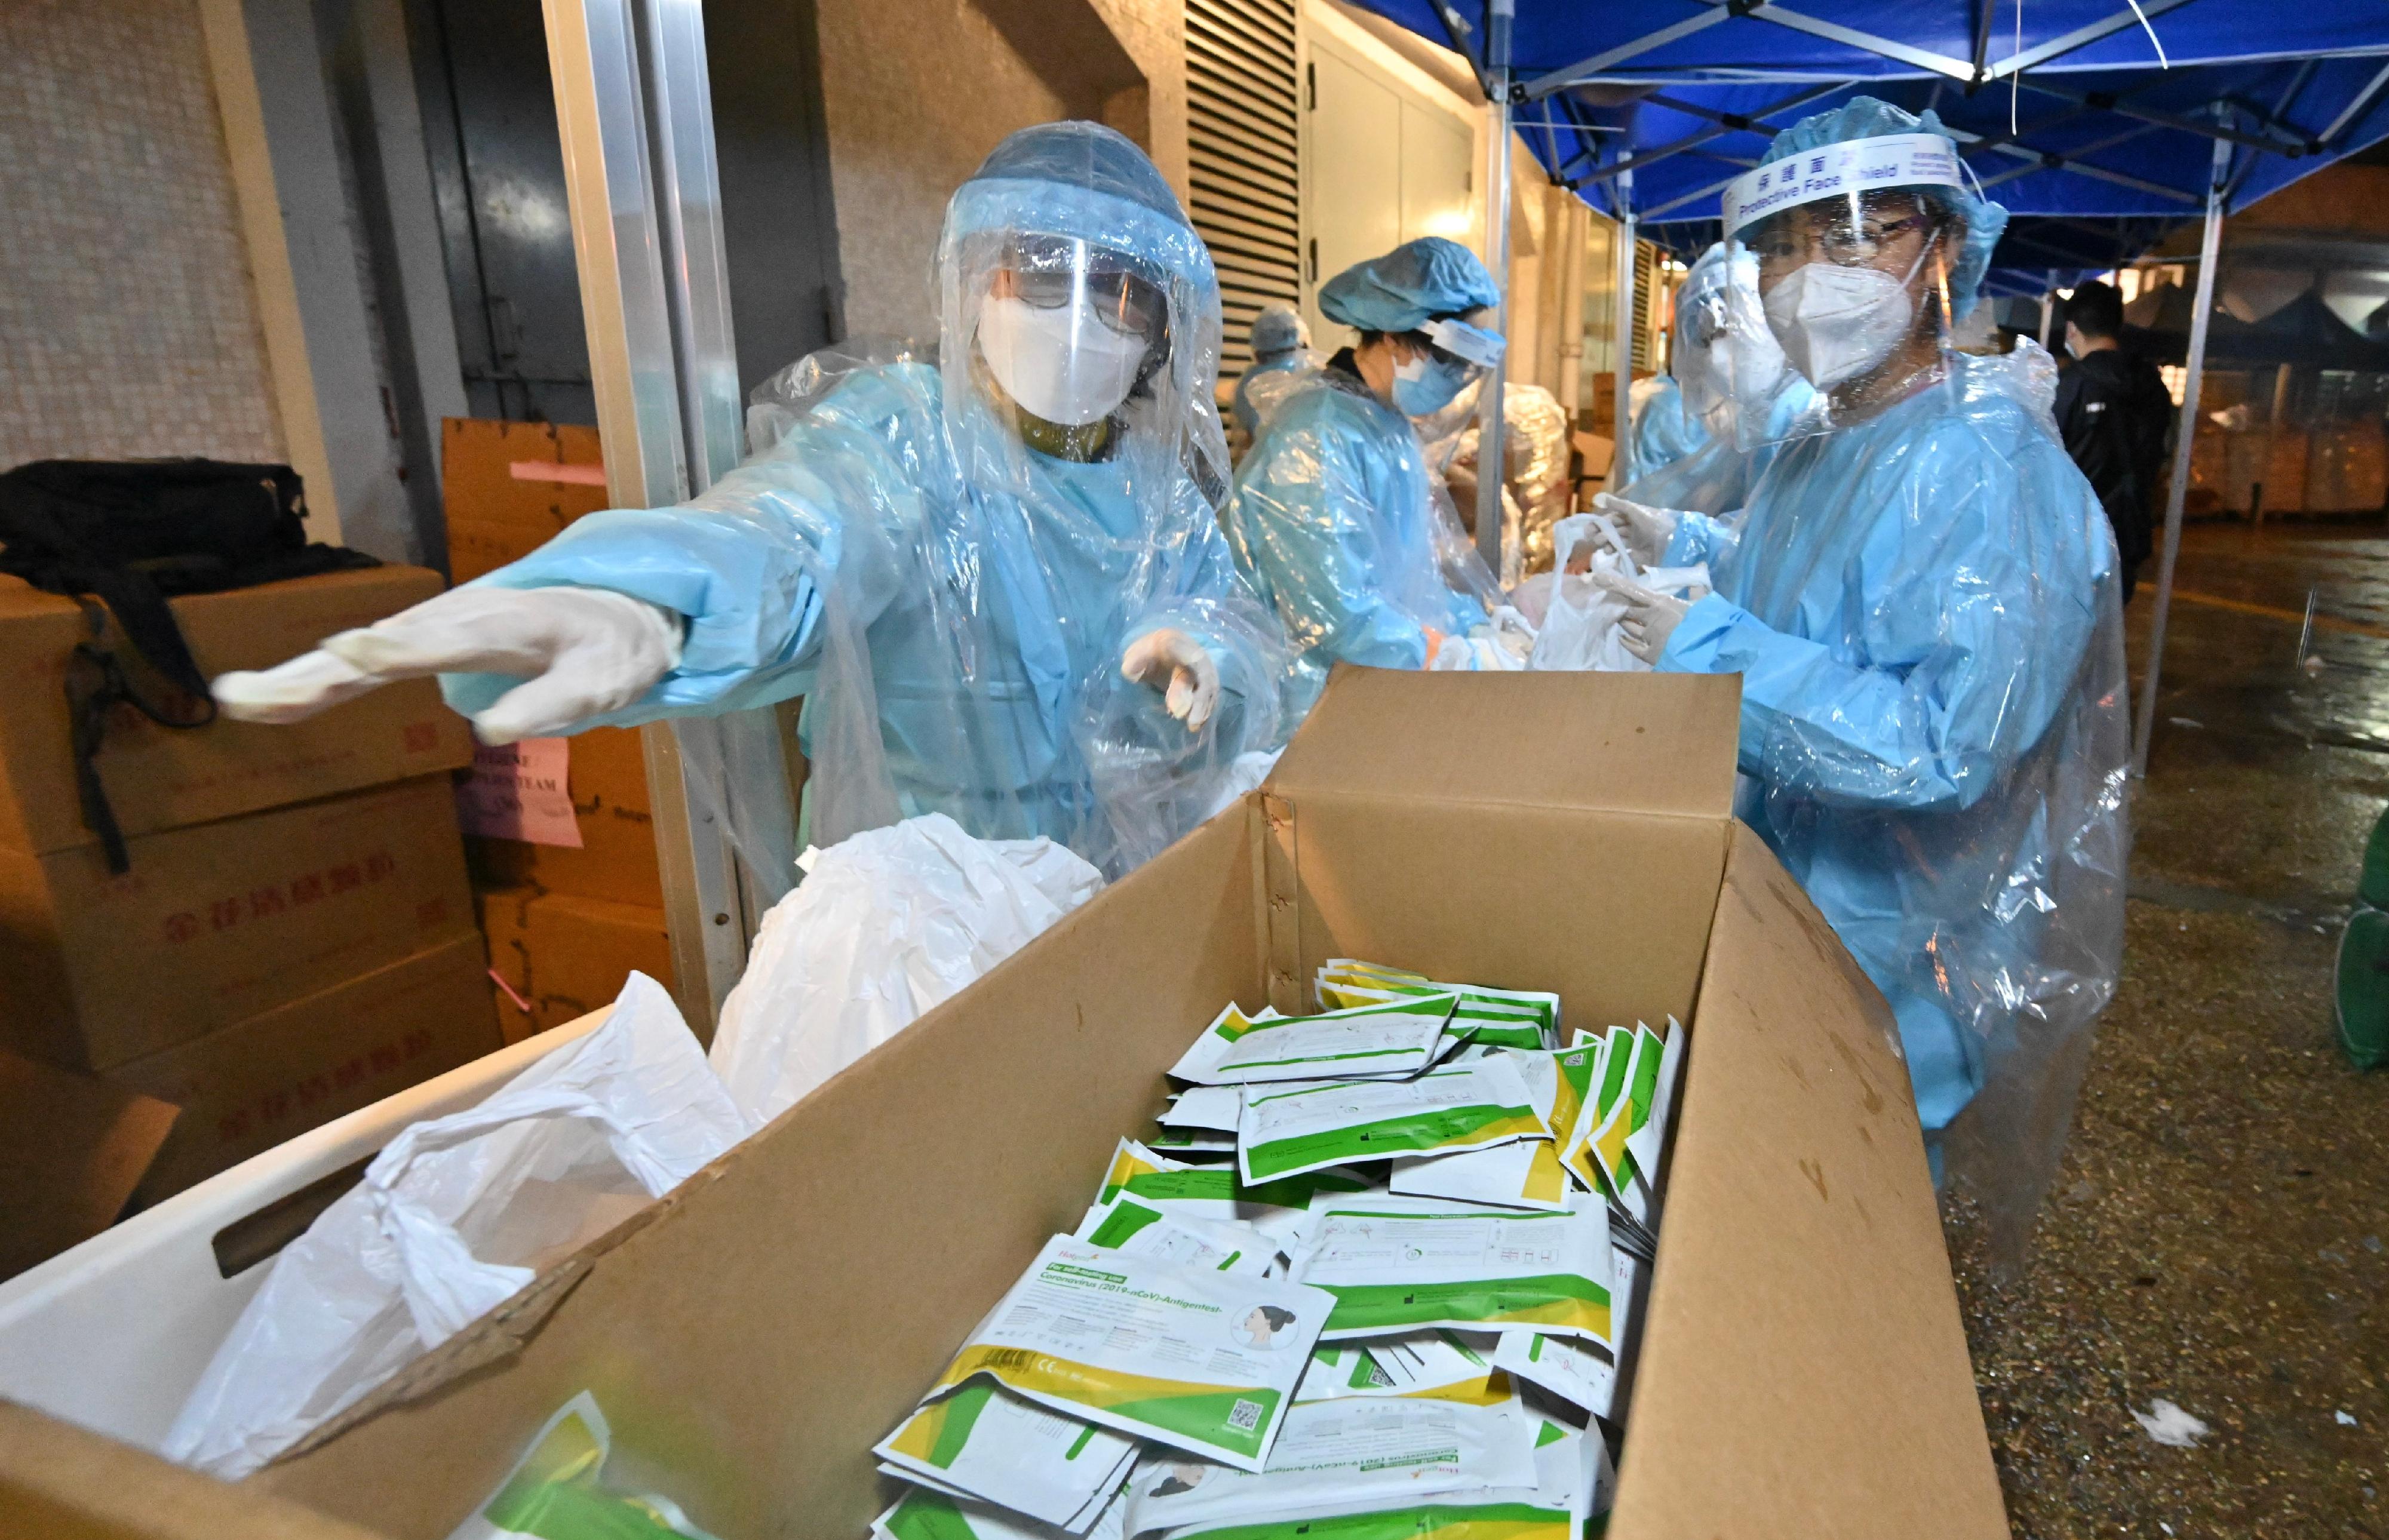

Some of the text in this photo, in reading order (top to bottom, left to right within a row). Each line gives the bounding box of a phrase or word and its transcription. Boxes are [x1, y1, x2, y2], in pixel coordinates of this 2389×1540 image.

[1739, 185, 1800, 219] Protective
[1804, 176, 1843, 195] Face
[1849, 163, 1900, 183] hield
[1040, 1271, 1097, 1286] Coronavirus
